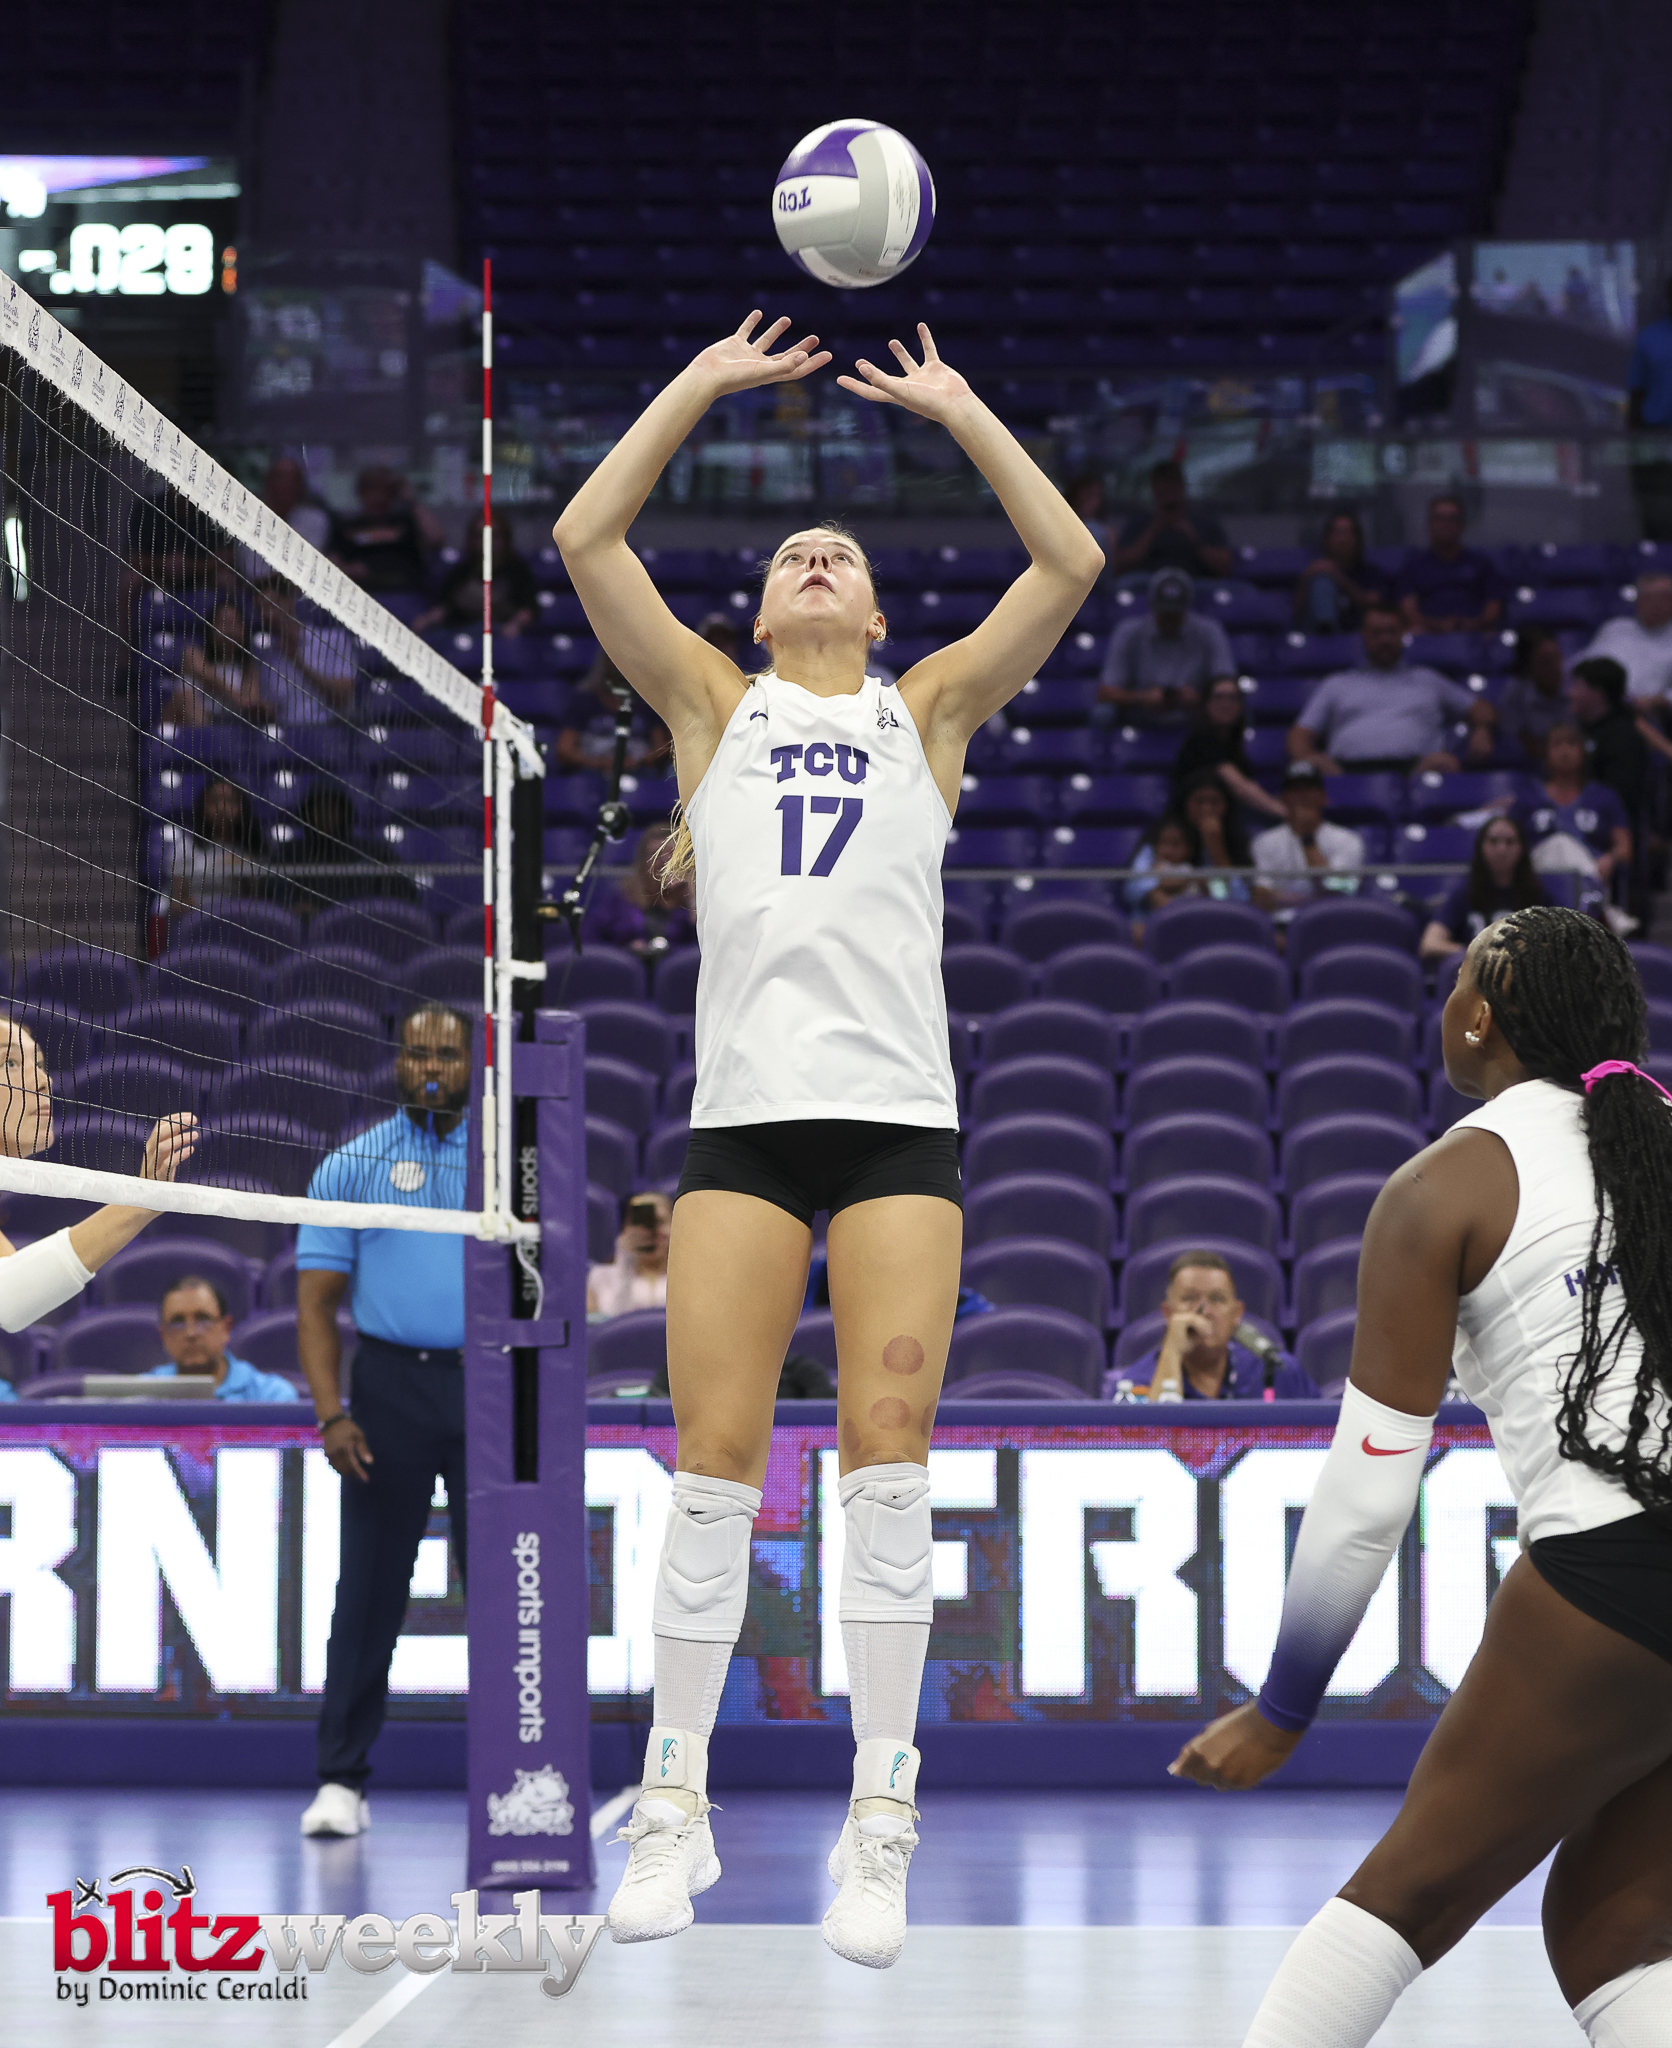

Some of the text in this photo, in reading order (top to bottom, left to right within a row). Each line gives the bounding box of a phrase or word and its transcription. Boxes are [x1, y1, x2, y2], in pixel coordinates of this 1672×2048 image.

[778, 186, 811, 212] TCU
[770, 742, 869, 785] TCU
[774, 794, 864, 877] 17
[519, 1146, 538, 1215] sports
[511, 1532, 545, 1743] sports imports
